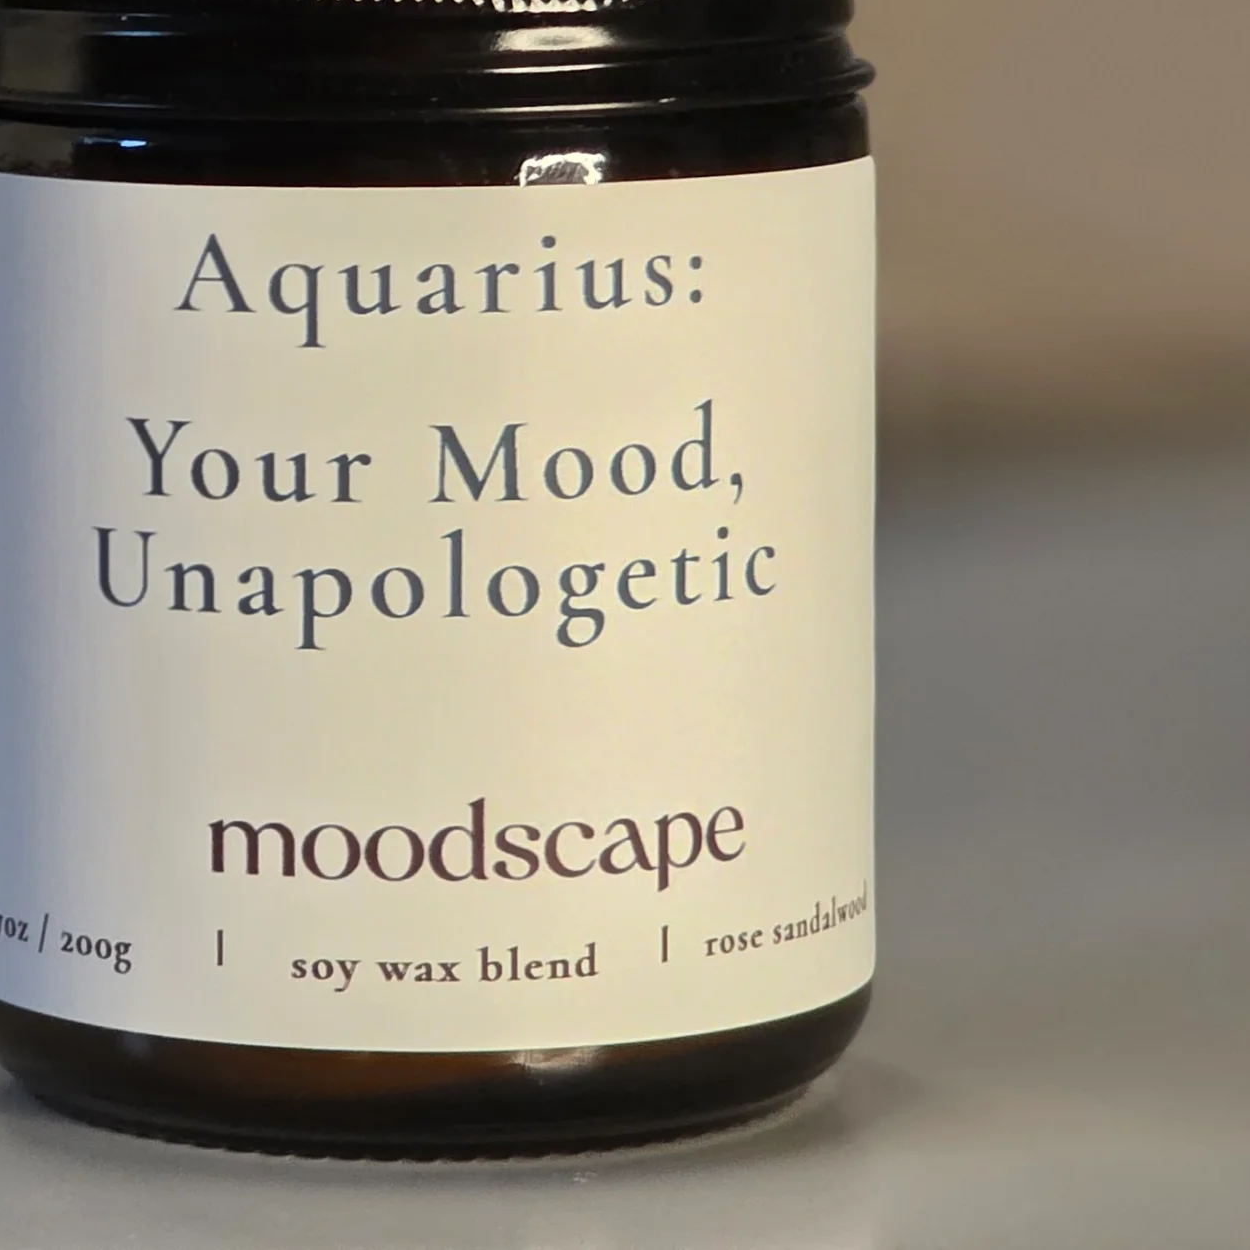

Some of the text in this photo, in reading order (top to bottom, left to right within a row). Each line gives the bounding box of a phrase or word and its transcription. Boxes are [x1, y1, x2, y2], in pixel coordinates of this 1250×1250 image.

[174, 233, 704, 349] Aquarius:
[126, 398, 744, 505] Your Mood,
[93, 526, 776, 651] Unapologetic
[208, 796, 747, 893] moodscape
[60, 931, 133, 975] 200g
[290, 957, 362, 993] soy
[376, 960, 461, 983] wax
[477, 944, 600, 983] blend
[704, 929, 764, 957] rose
[772, 879, 868, 946] sandalwood
